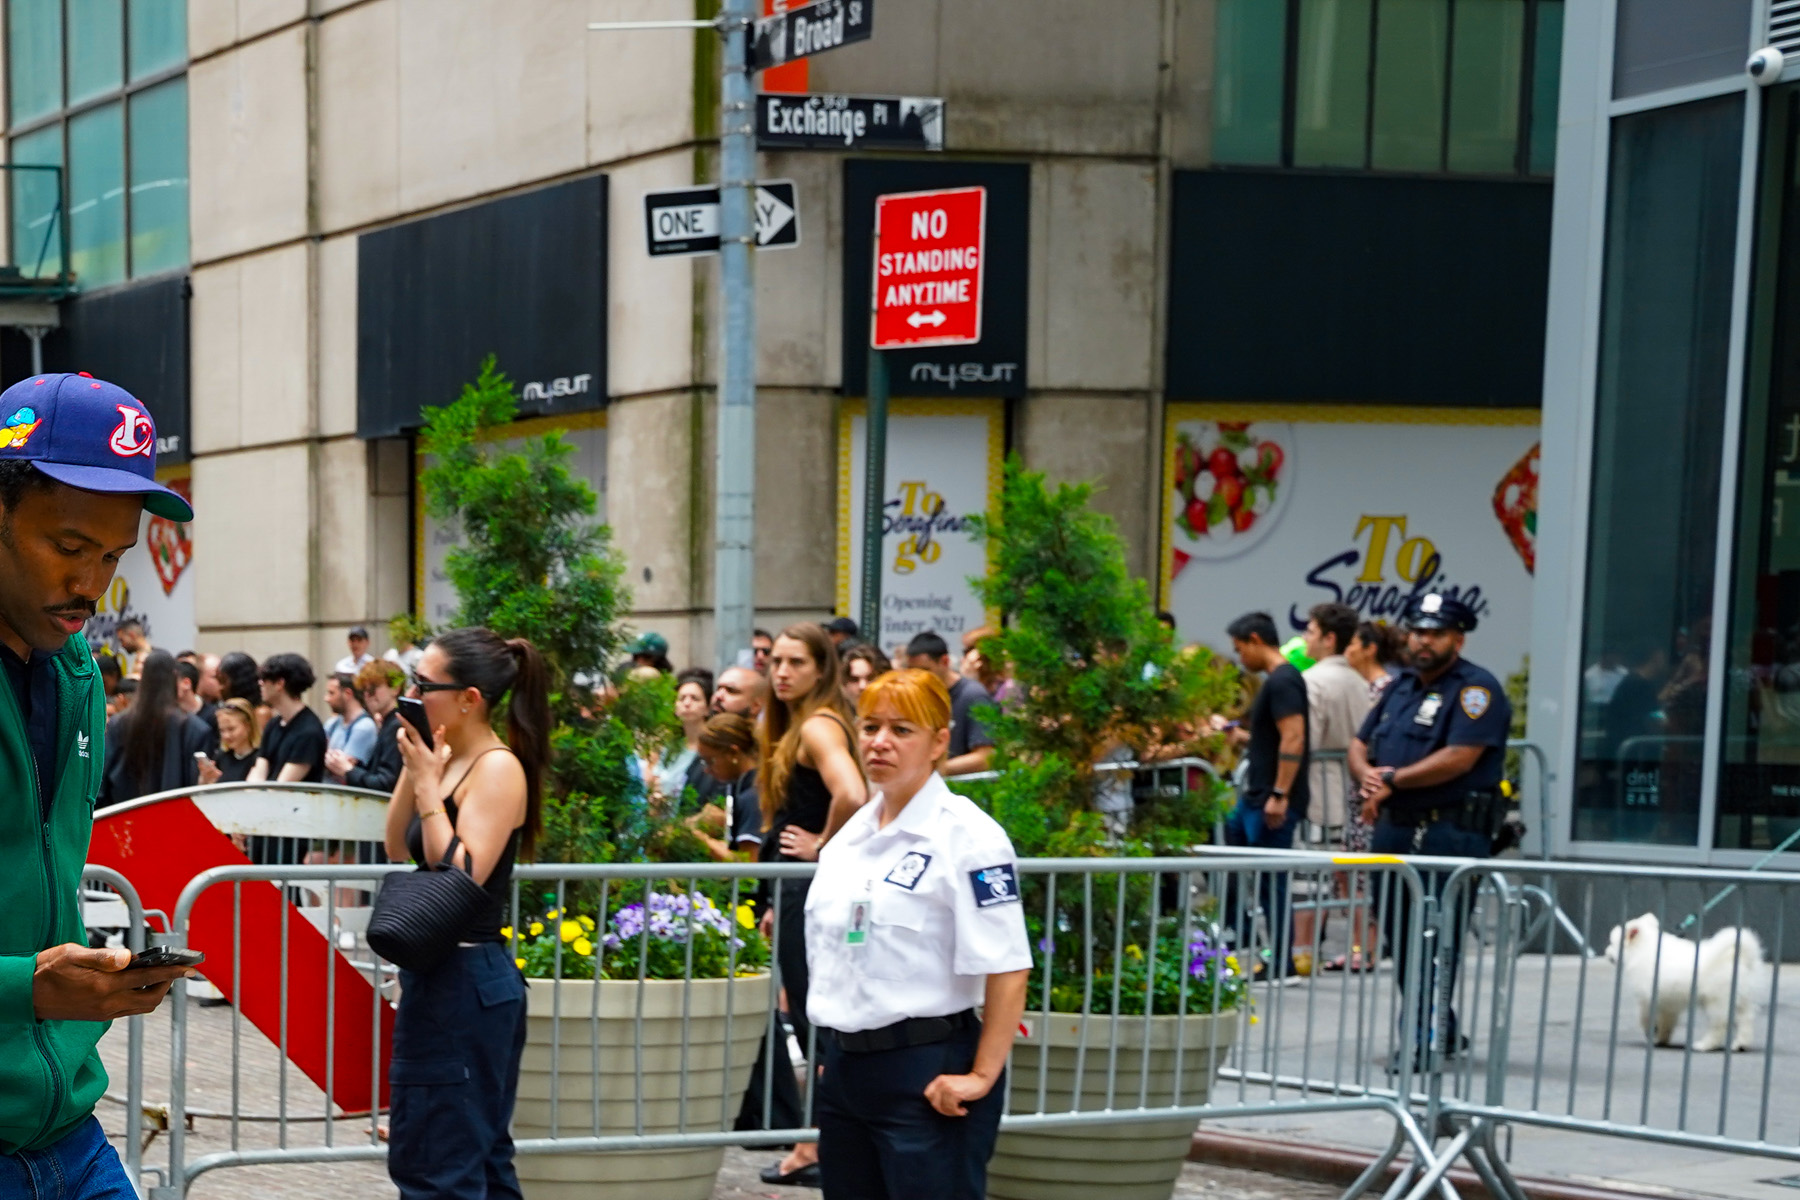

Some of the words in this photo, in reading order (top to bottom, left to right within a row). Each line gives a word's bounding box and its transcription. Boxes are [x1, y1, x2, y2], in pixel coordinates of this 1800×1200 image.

[794, 4, 844, 56] Broad
[767, 98, 866, 146] Exchange
[873, 103, 888, 125] Pl
[659, 210, 704, 236] ONE
[911, 208, 948, 240] NO
[880, 246, 977, 276] STANDING
[884, 278, 971, 307] ANYTIME
[898, 481, 943, 516] To
[1352, 513, 1437, 584] To
[884, 592, 953, 613] Opening
[883, 616, 925, 633] inter
